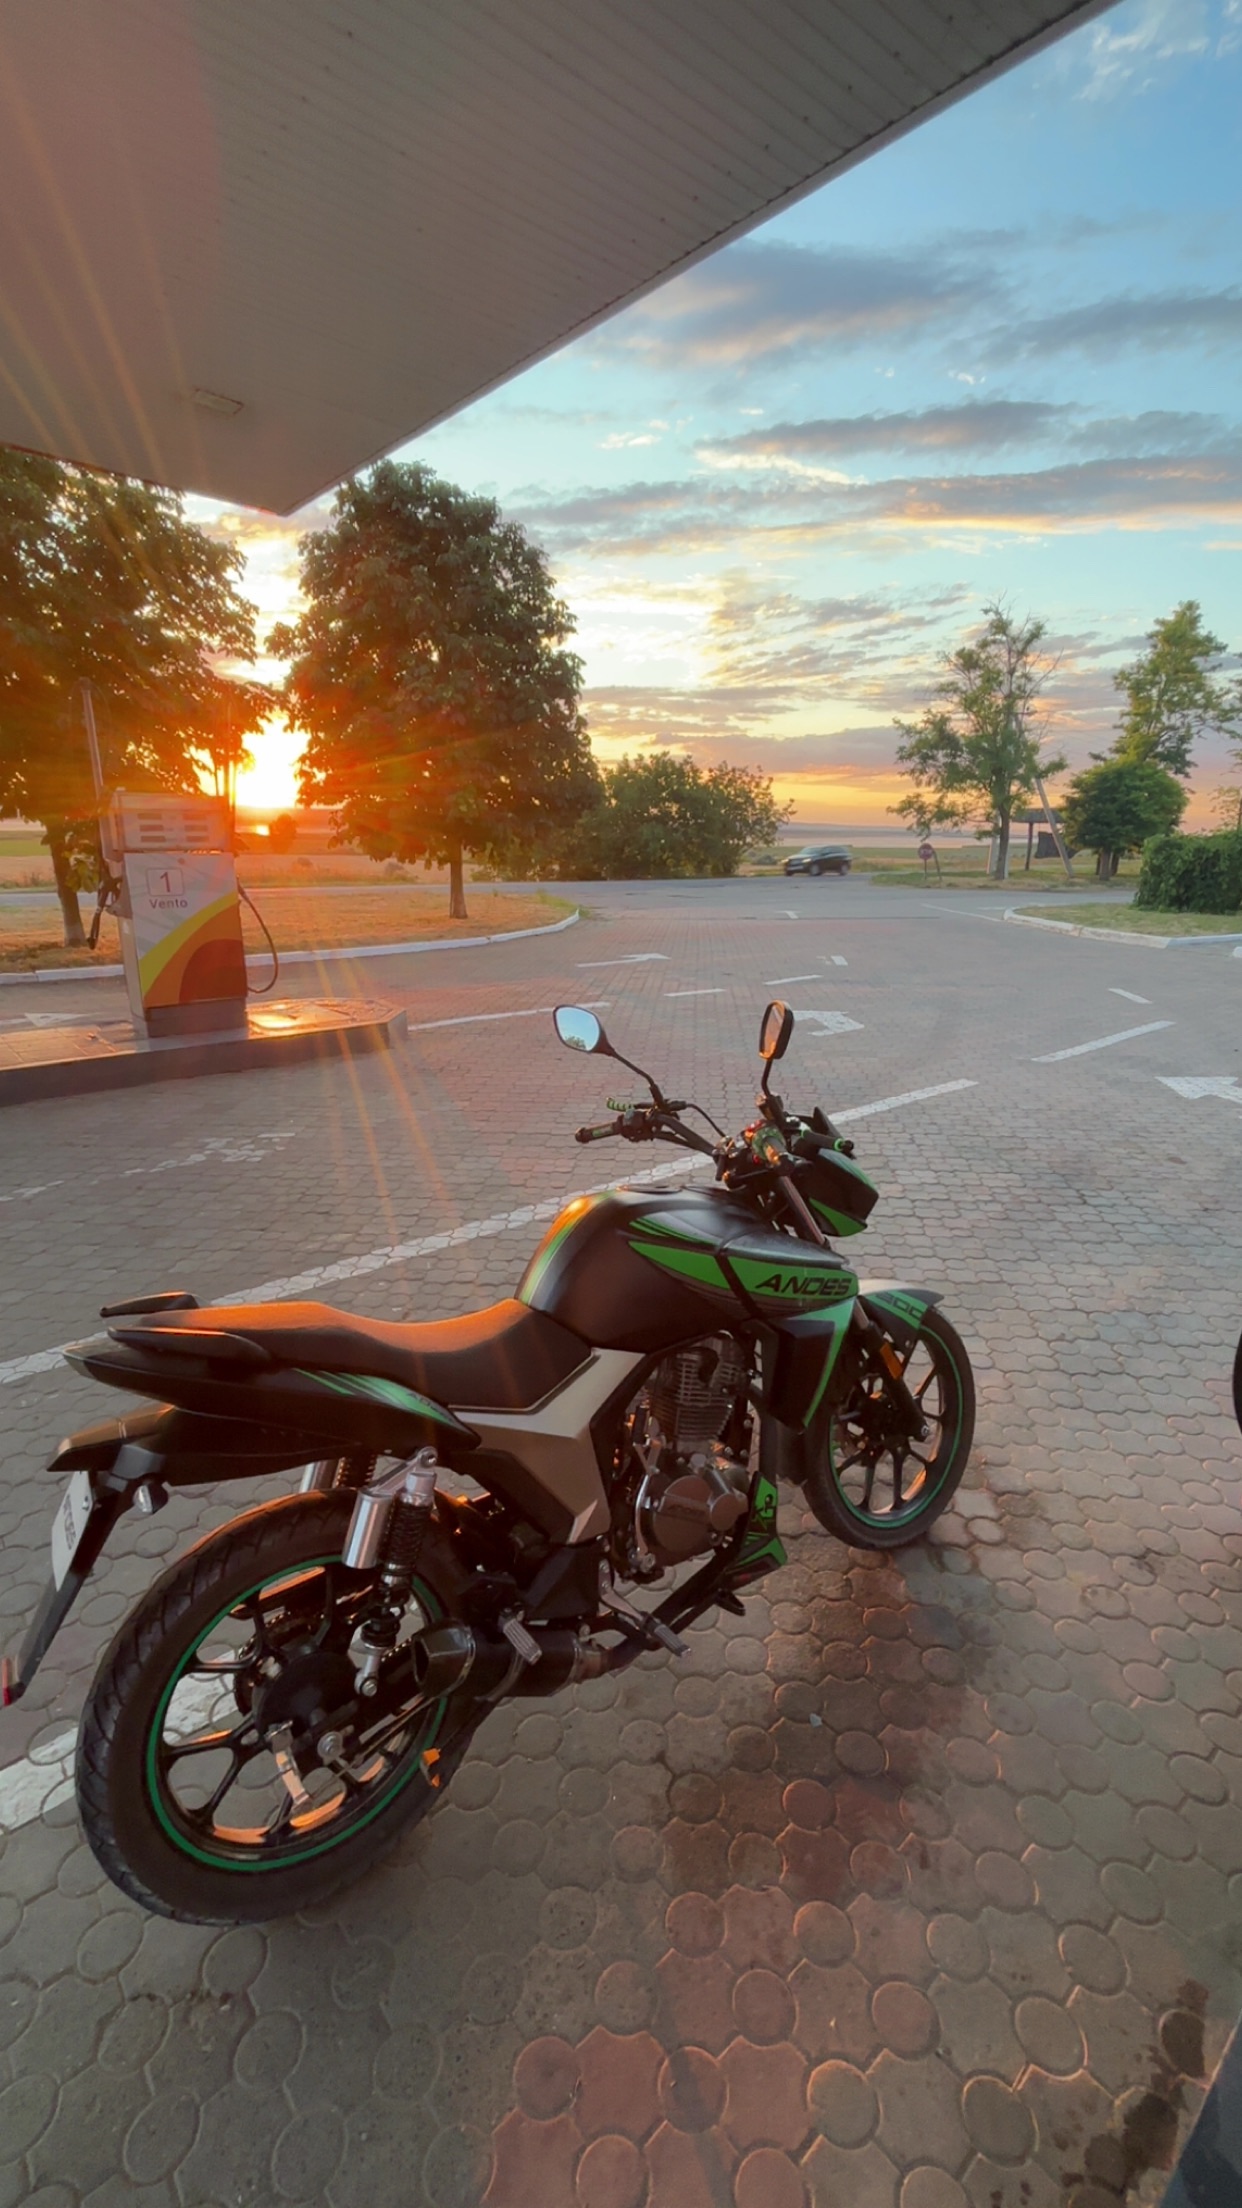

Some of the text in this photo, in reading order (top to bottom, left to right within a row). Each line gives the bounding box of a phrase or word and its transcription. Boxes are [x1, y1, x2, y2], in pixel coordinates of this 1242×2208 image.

[160, 871, 171, 893] 1
[149, 898, 188, 909] Vento
[755, 1273, 852, 1296] ANDES
